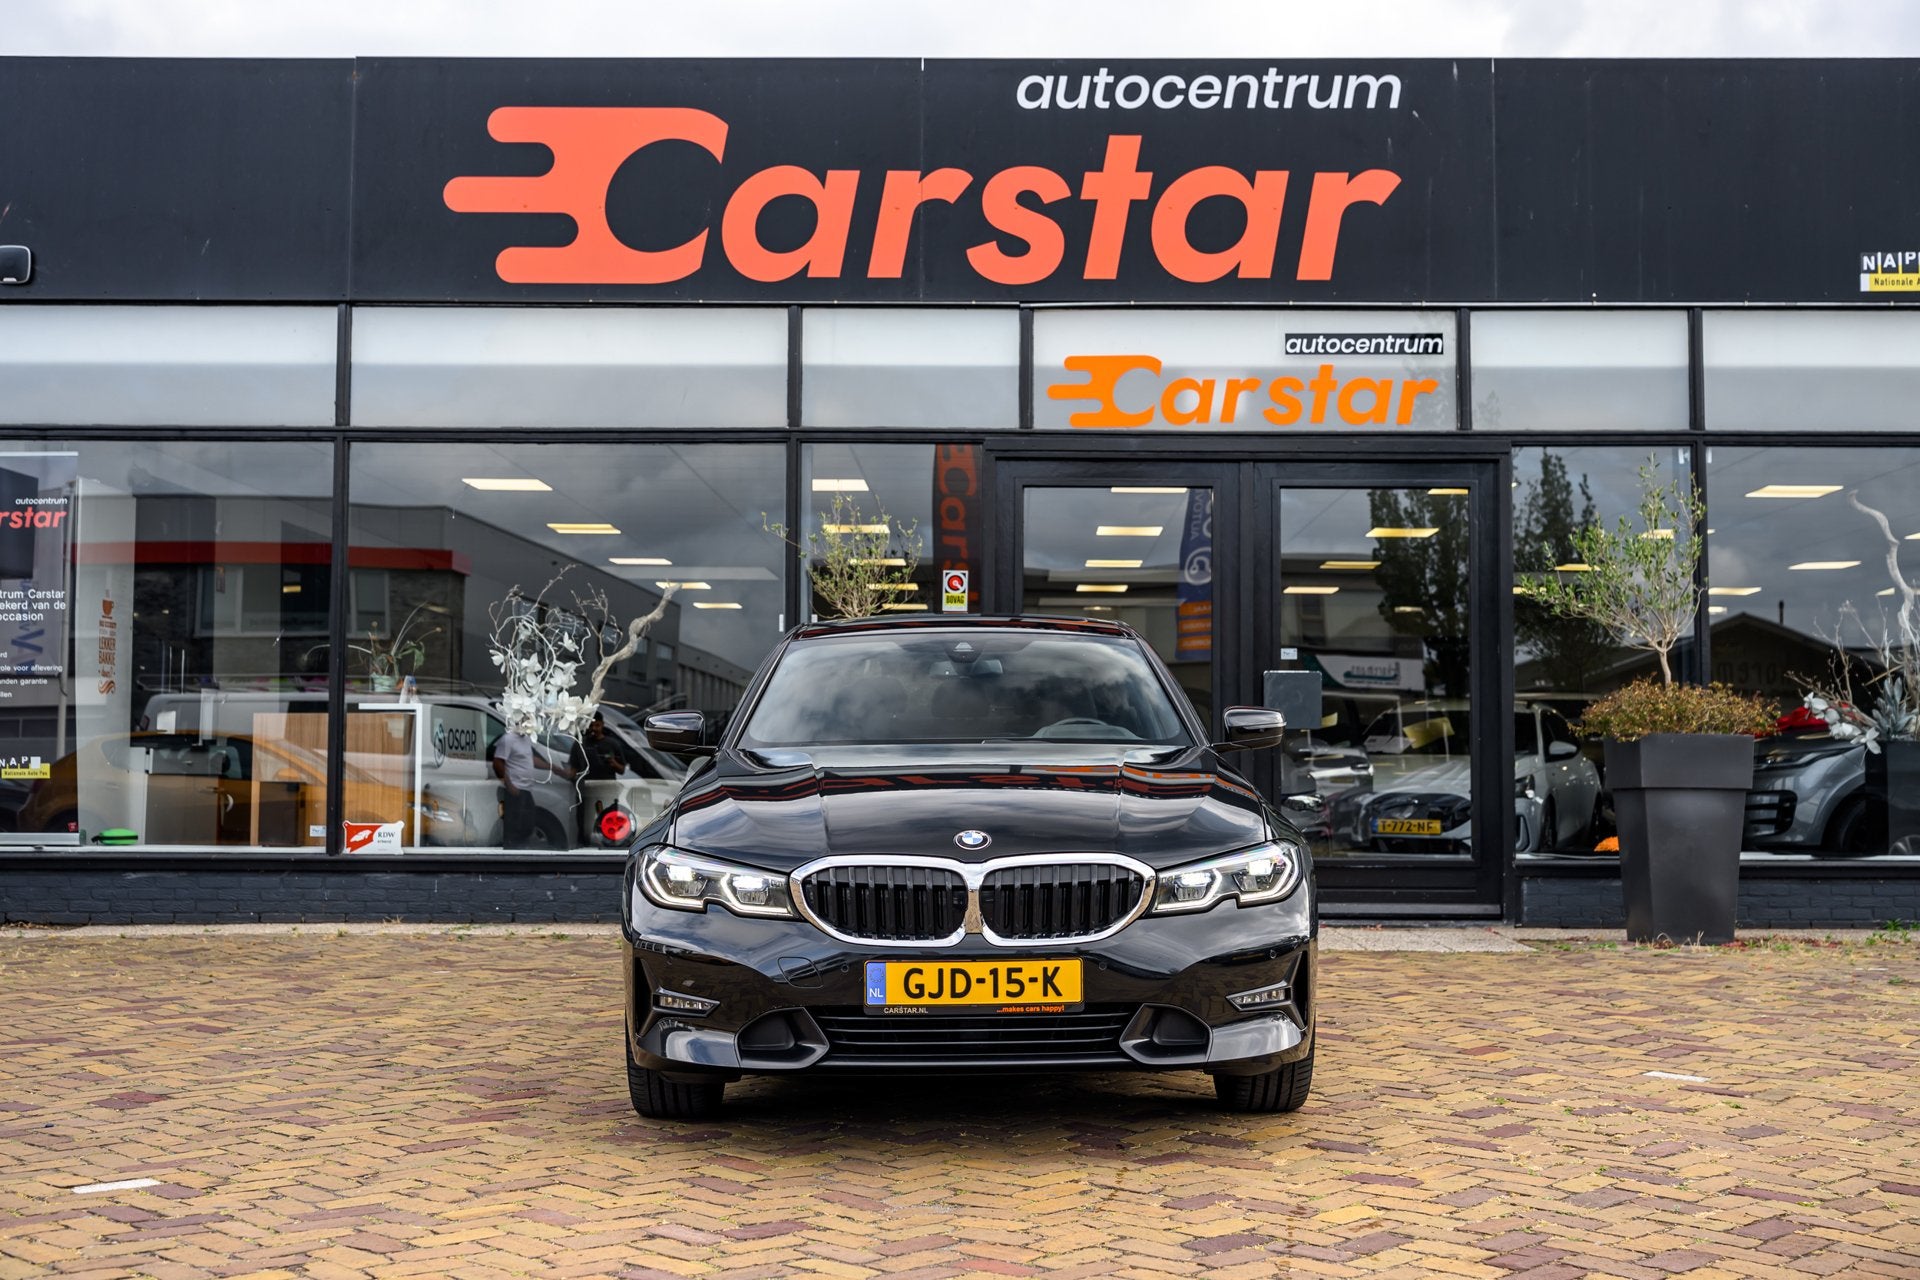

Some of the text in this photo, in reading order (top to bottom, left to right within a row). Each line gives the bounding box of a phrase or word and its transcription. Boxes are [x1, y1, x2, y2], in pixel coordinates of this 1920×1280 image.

[1016, 66, 1402, 111] autocentrum
[443, 106, 1402, 285] Carstar
[1874, 277, 1914, 287] Nationale
[1285, 333, 1443, 354] autocentrum
[1046, 354, 1439, 428] Carstar
[15, 496, 68, 505] autocentrum
[28, 589, 65, 599] Carstar
[945, 594, 965, 604] BOVAG
[32, 602, 50, 610] van
[53, 601, 66, 610] de
[20, 678, 48, 686] garantie
[447, 728, 477, 752] OSCAR
[1380, 820, 1433, 832] T-772-NF
[903, 966, 1063, 999] GJD-15-K
[869, 988, 884, 998] NL
[1041, 1004, 1065, 1013] happy!
